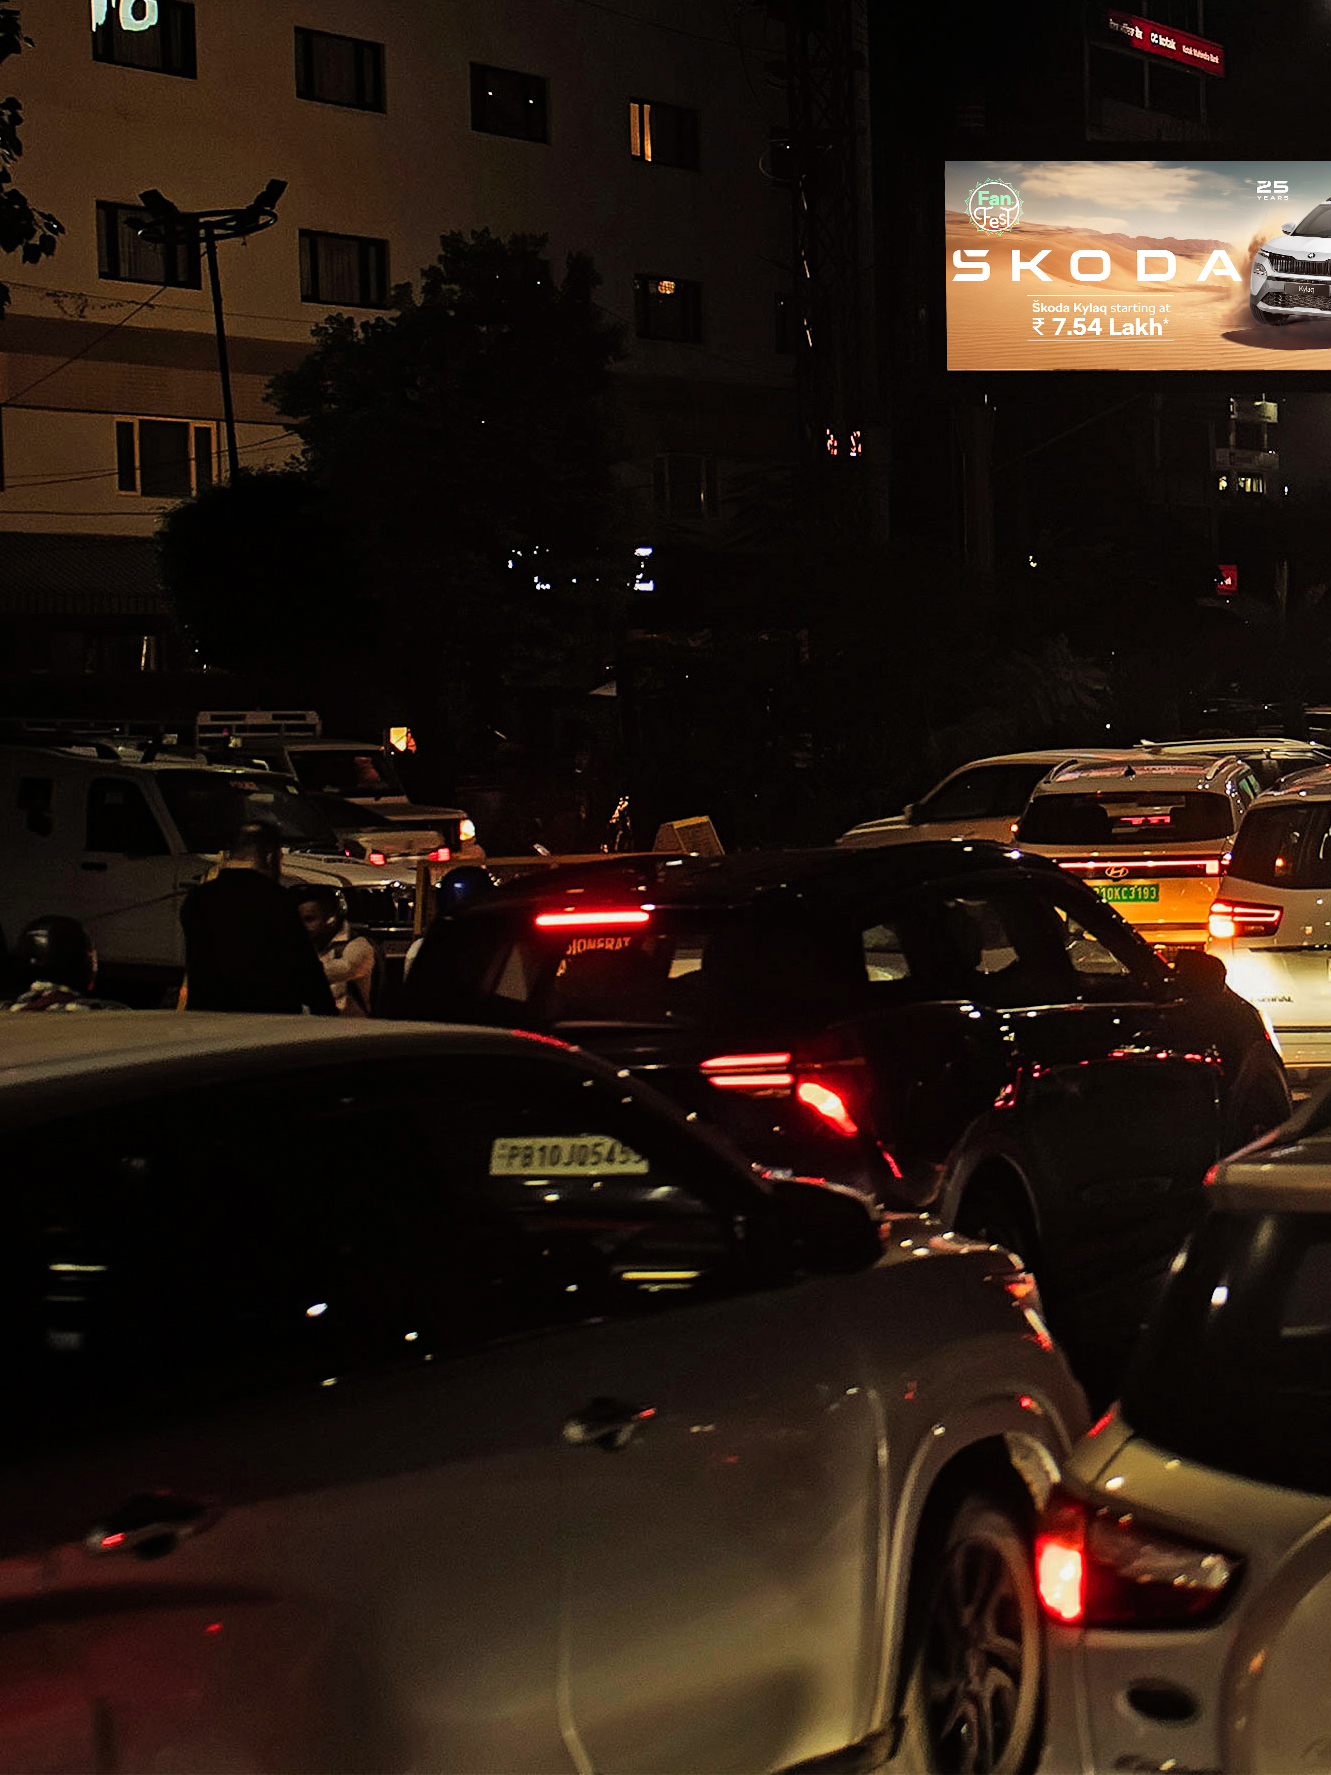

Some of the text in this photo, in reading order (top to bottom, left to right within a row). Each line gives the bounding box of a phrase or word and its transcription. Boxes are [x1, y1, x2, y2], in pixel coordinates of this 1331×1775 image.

[1256, 180, 1289, 194] 25
[978, 191, 1012, 206] Fan
[1032, 300, 1171, 315] Škoda Kylaq starting at
[1051, 317, 1103, 336] 7.54
